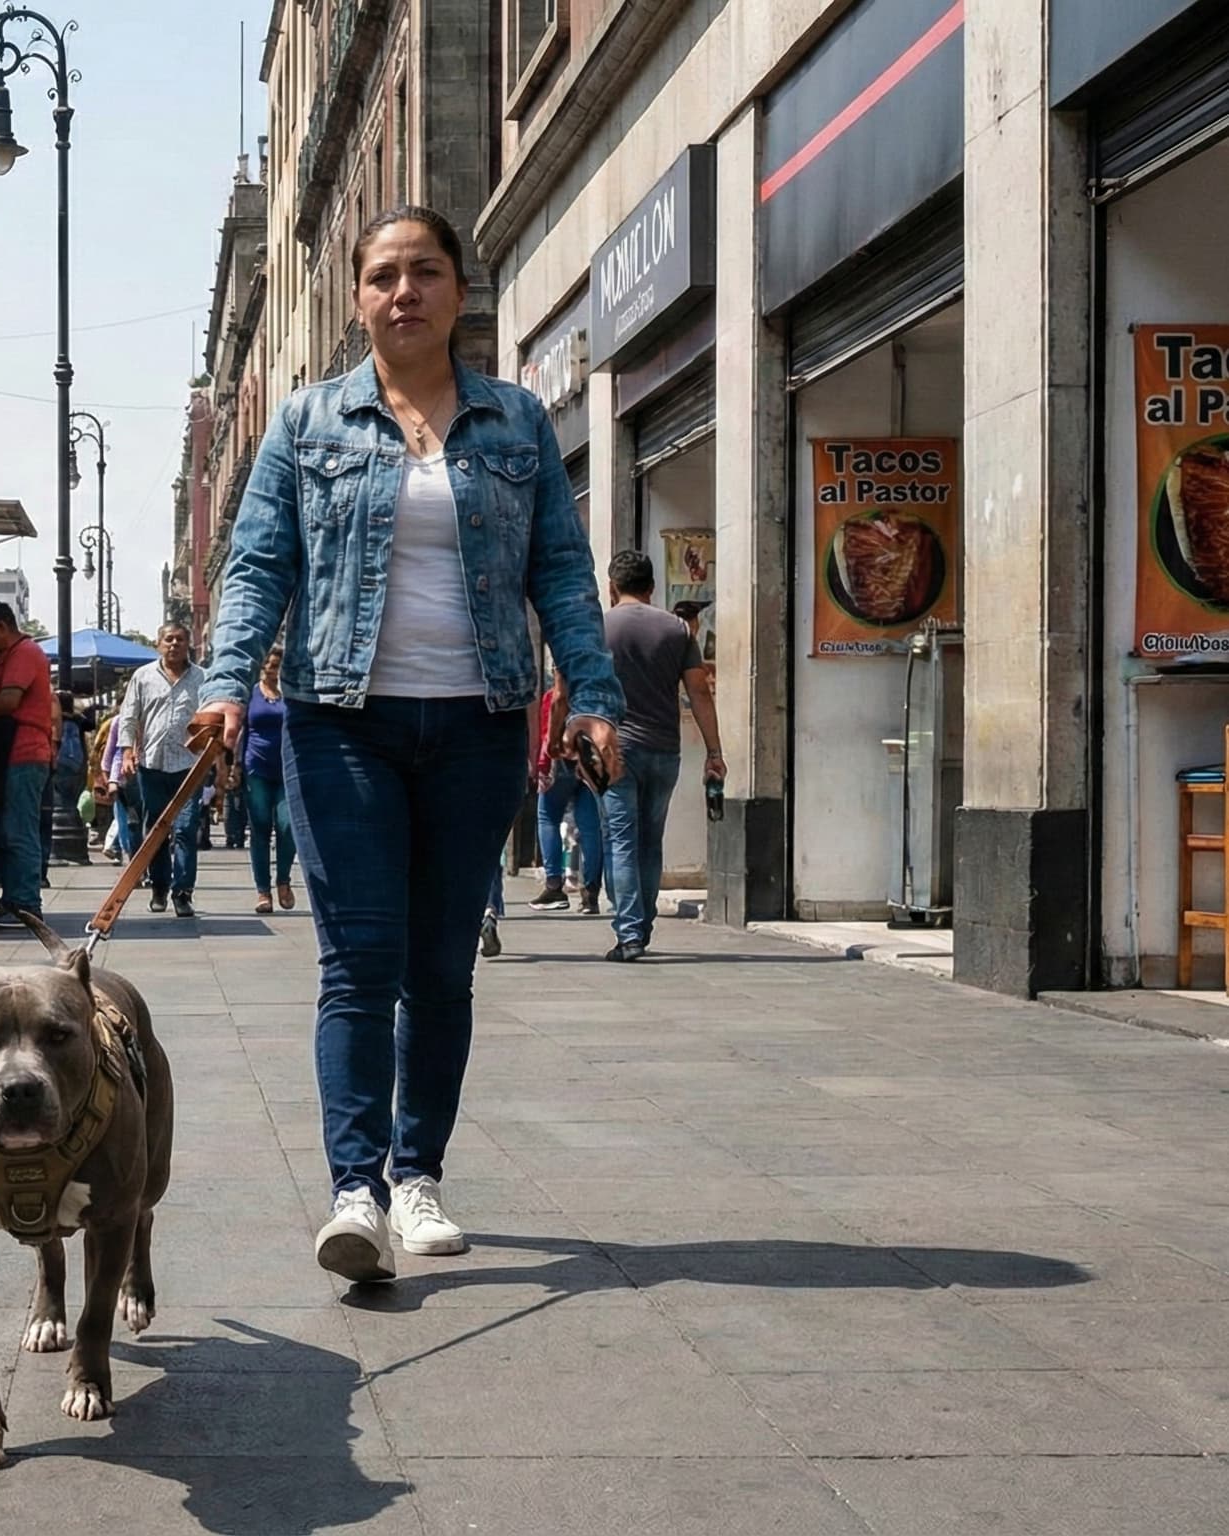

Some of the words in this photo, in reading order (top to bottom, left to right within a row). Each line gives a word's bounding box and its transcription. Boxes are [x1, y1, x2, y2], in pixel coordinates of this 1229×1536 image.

[1153, 333, 1229, 383] Ta
[1145, 386, 1186, 426] al
[1197, 386, 1229, 426] P
[825, 443, 942, 475] Tacos
[820, 479, 847, 503] al
[856, 477, 950, 503] Pastor
